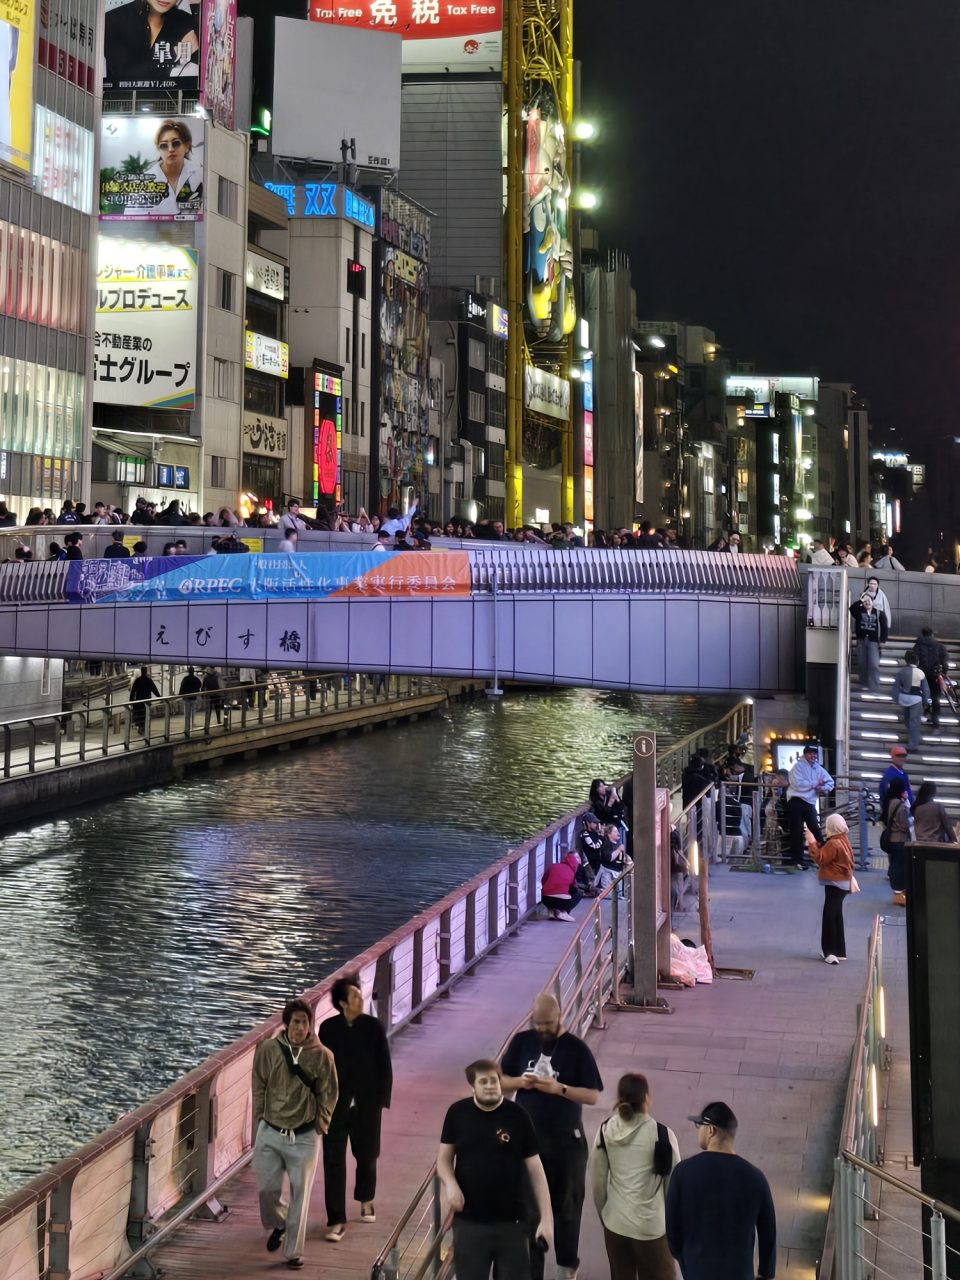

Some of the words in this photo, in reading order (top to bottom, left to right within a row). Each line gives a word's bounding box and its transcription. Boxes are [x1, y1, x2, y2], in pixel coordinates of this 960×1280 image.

[315, 8, 336, 18] Tax
[339, 7, 362, 18] Free
[447, 5, 467, 15] Tax
[471, 4, 496, 15] Free
[155, 624, 301, 653] えびす橋
